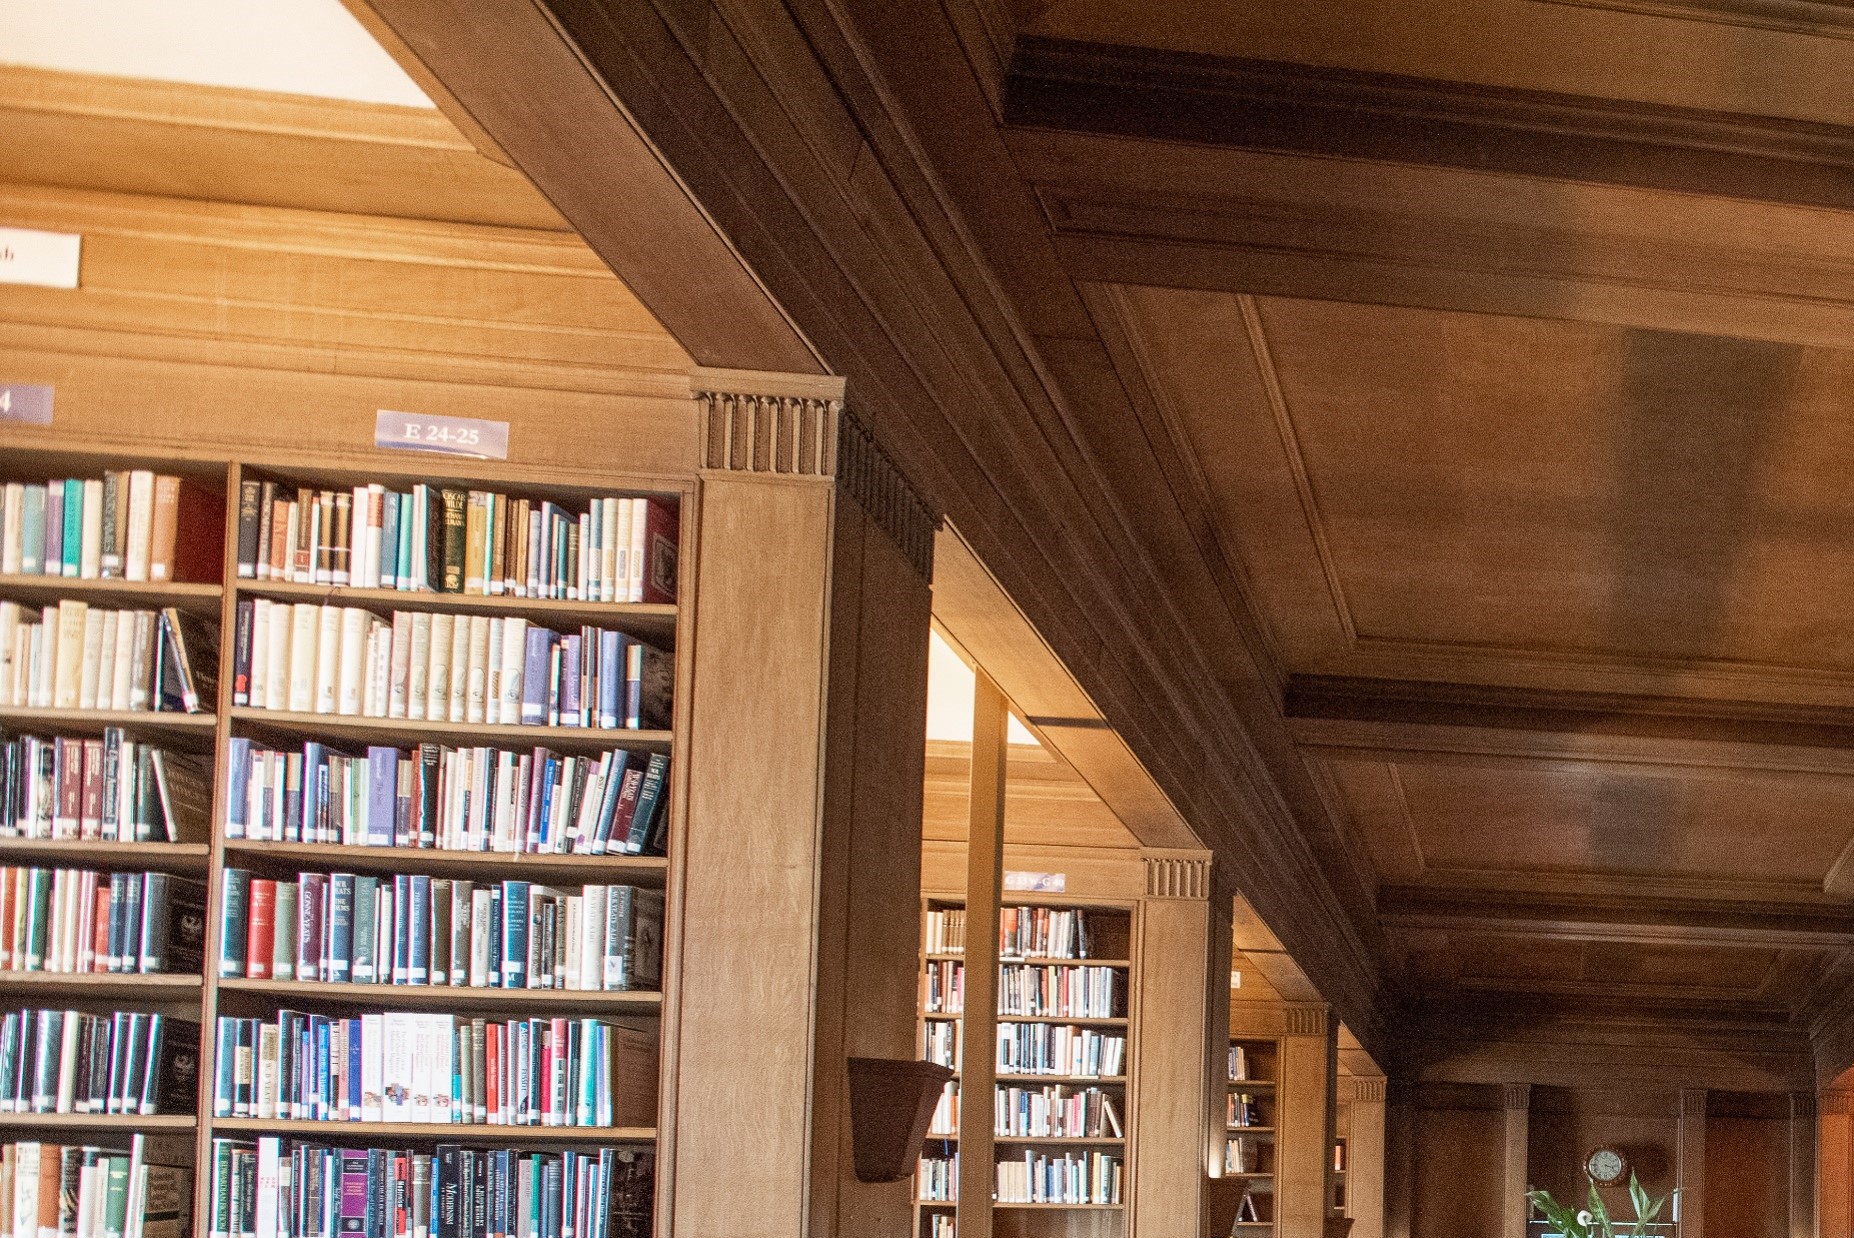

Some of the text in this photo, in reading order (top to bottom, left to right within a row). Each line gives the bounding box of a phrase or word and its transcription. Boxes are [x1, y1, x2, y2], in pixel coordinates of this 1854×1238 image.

[405, 424, 479, 445] E 24-25
[446, 1183, 458, 1225] MODERNISM
